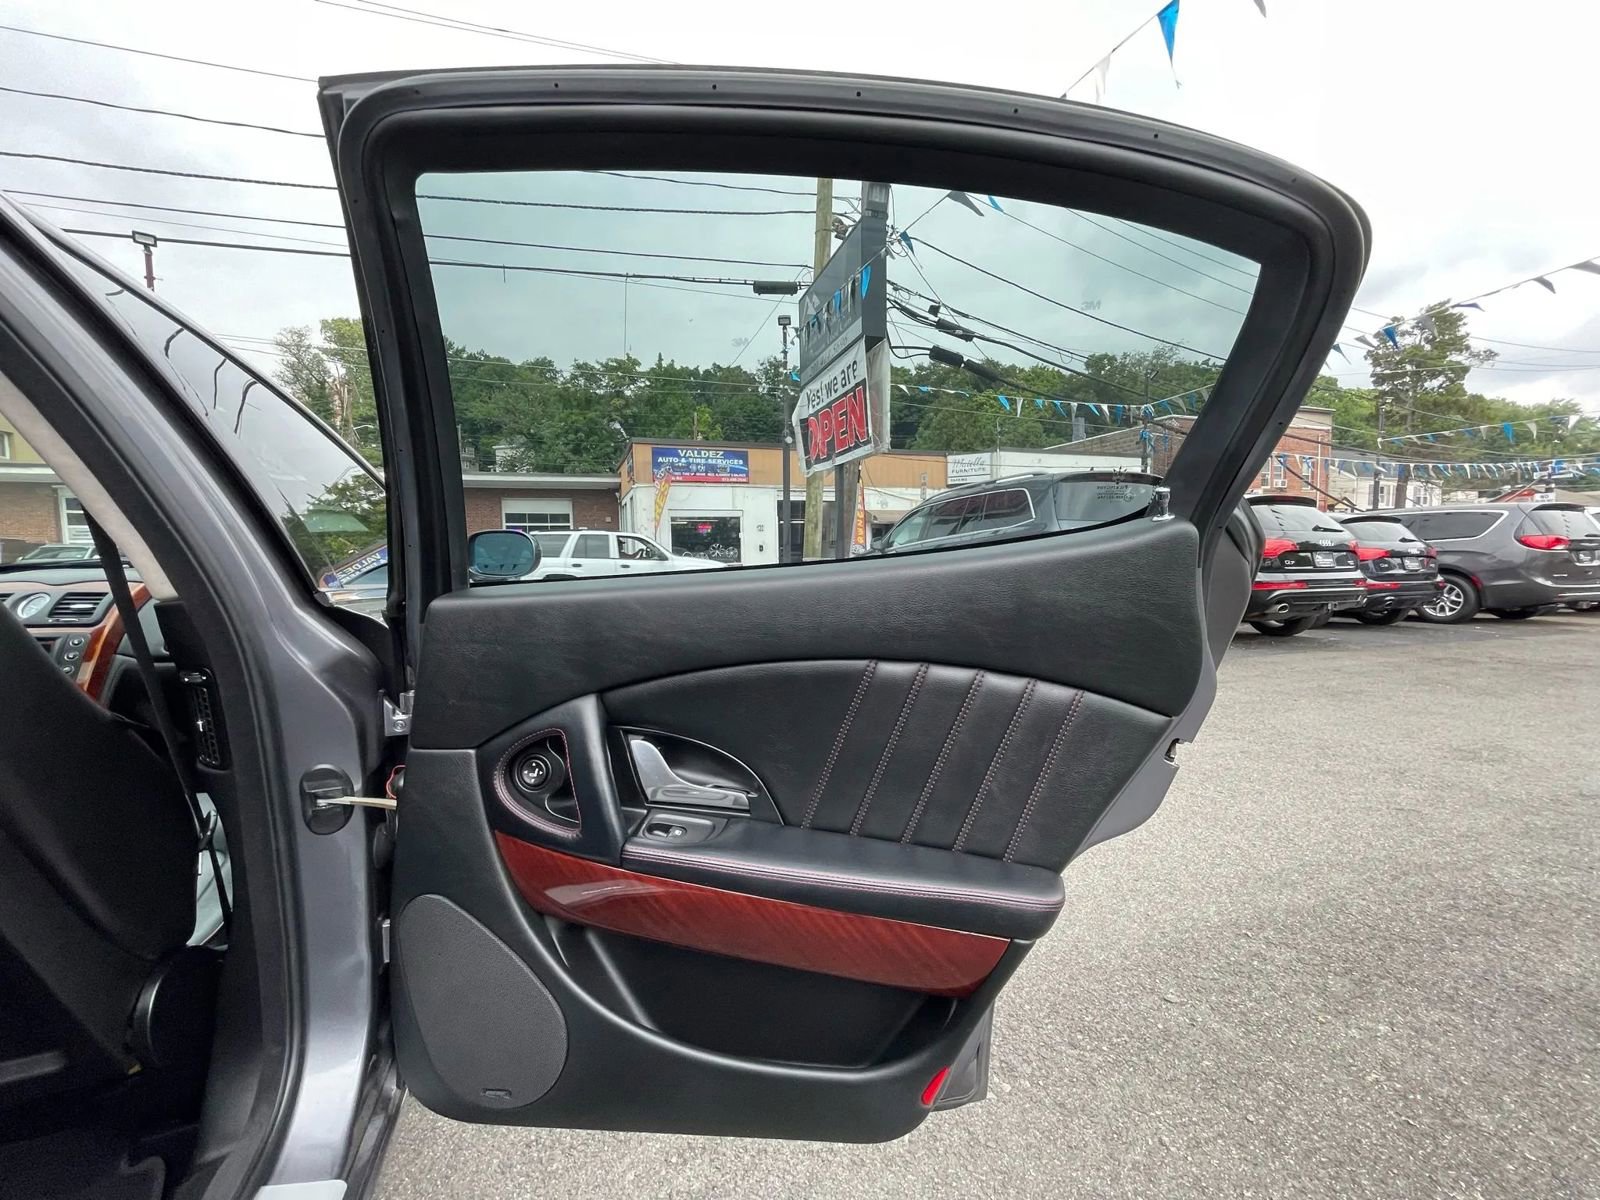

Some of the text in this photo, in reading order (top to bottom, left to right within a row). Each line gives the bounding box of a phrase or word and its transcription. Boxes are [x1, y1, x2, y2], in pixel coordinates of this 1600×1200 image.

[806, 359, 858, 409] Yes! we are
[808, 386, 868, 463] OPEN
[678, 449, 724, 458] VALDEZ
